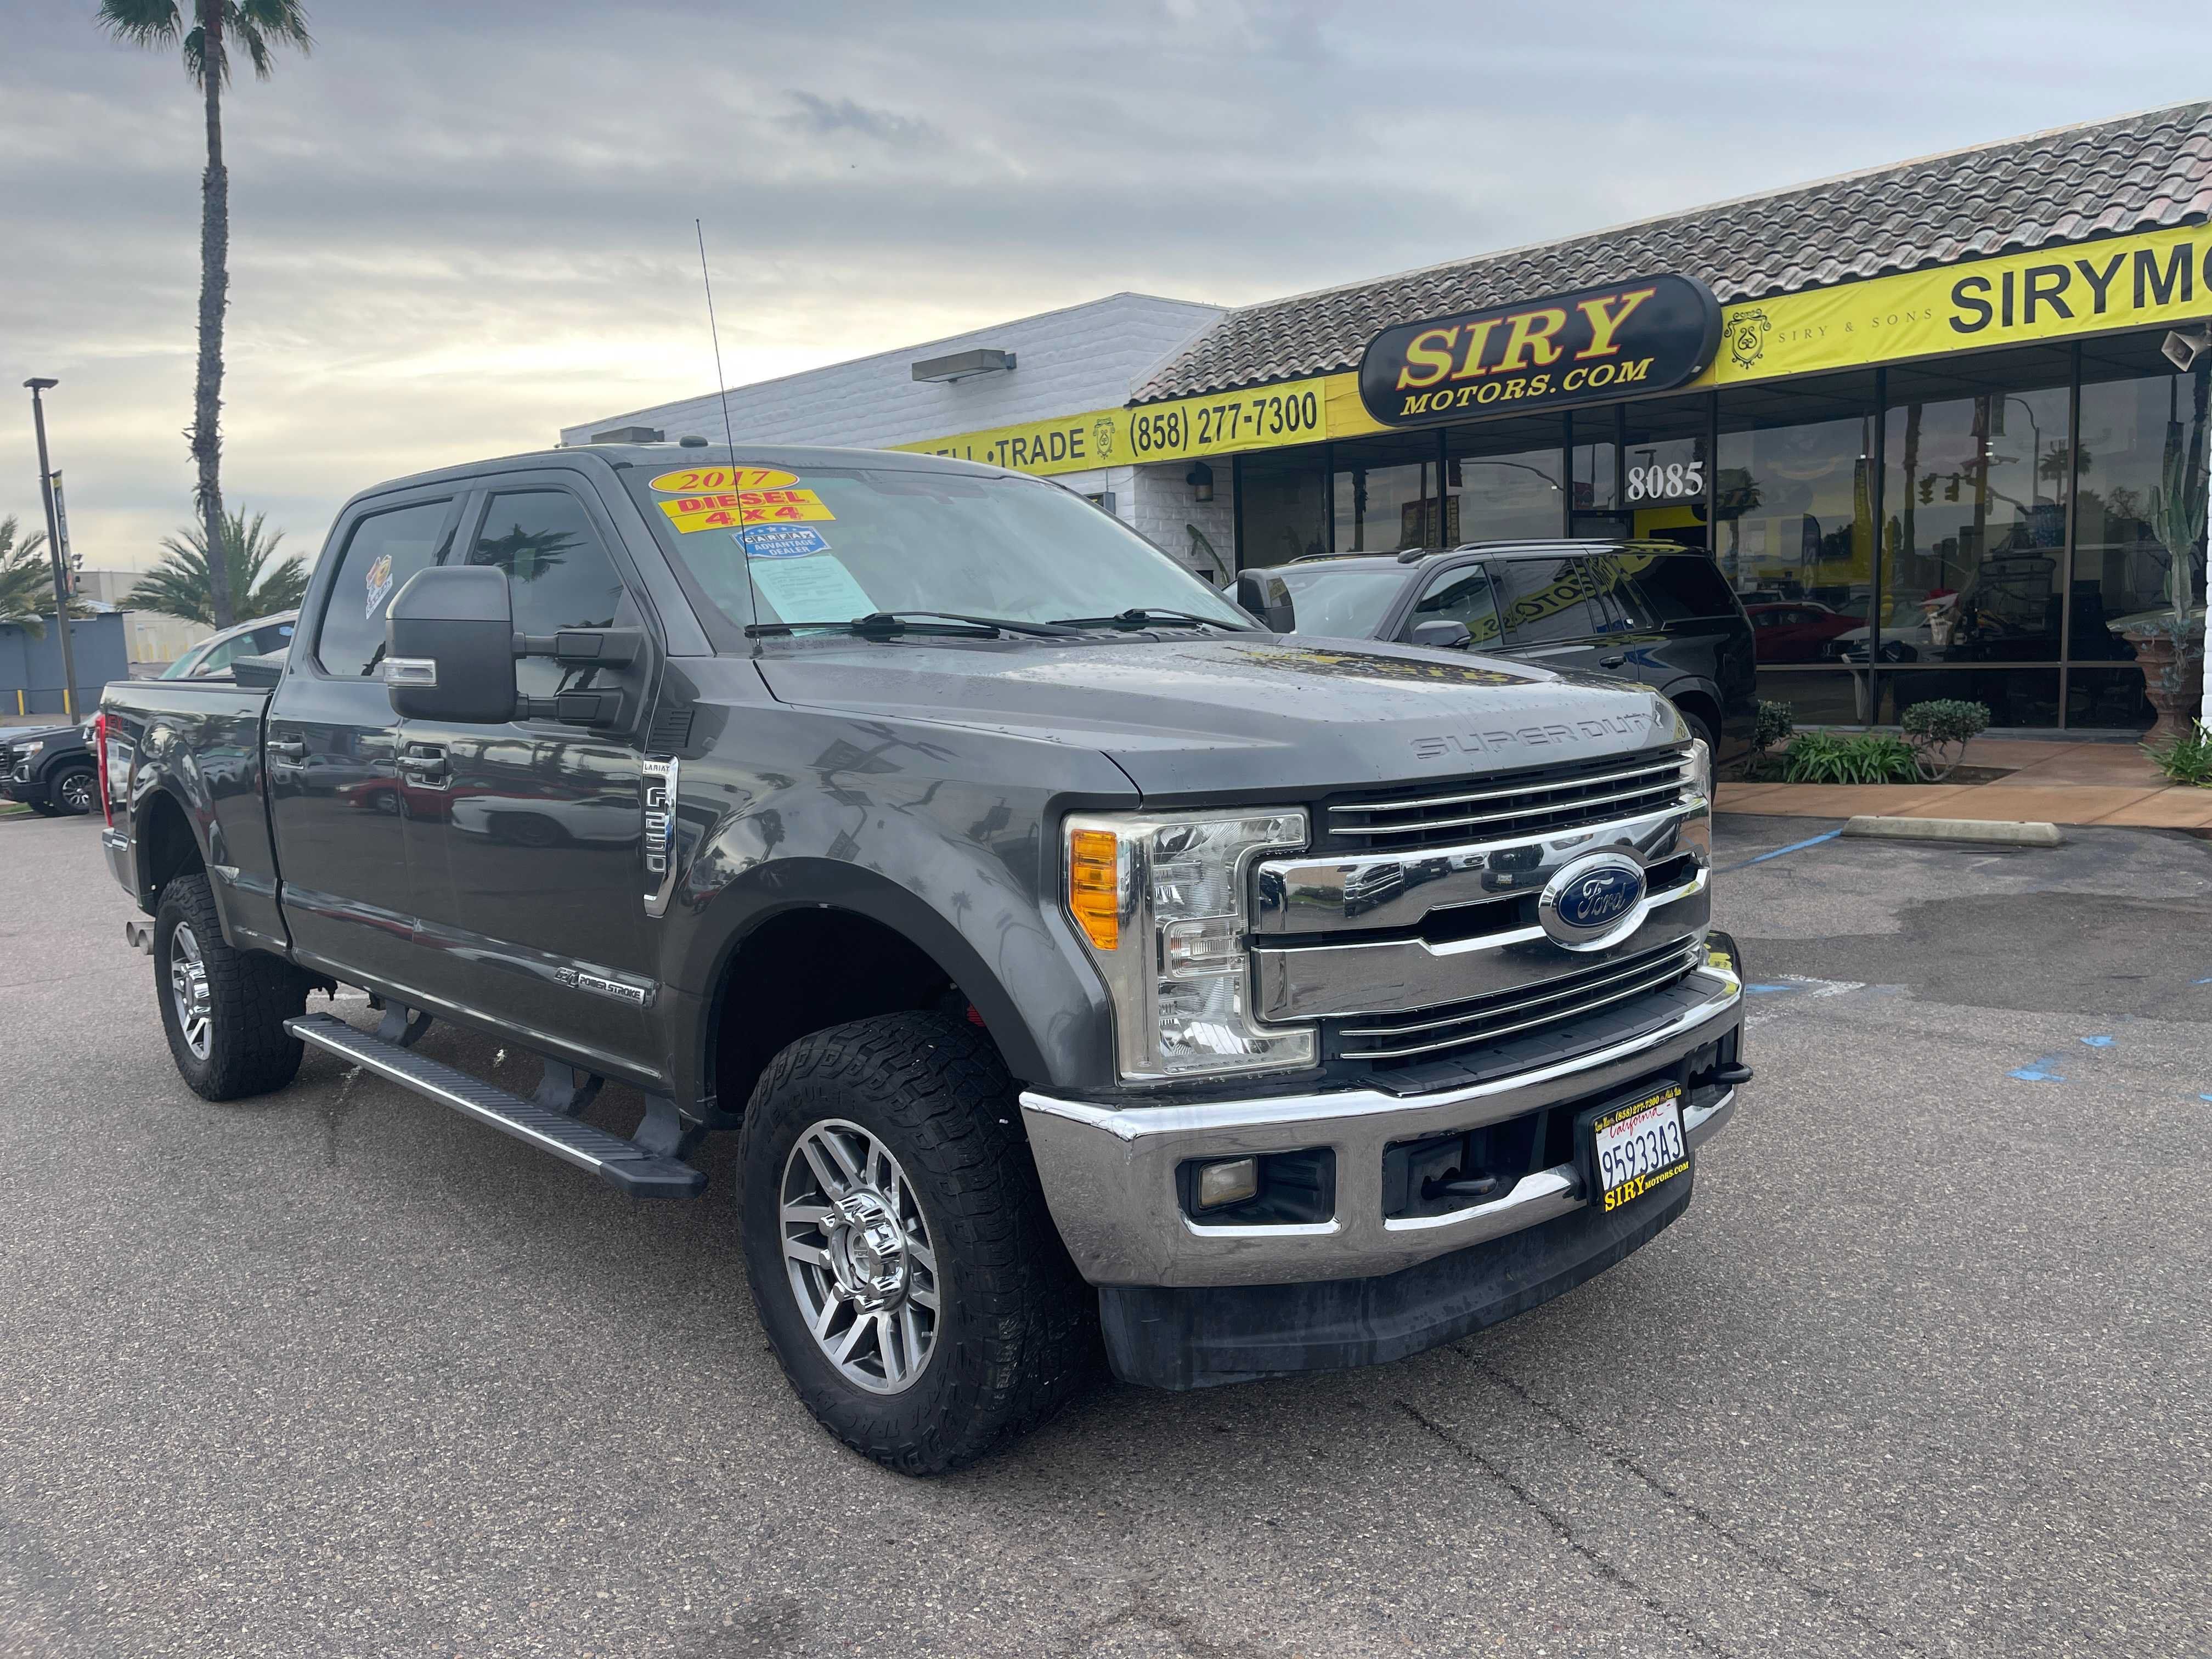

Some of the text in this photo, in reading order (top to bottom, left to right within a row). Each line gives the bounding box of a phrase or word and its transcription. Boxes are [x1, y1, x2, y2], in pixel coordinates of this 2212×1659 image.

[1949, 242, 2212, 333] SIRYM
[1396, 287, 1656, 390] SIRY
[1778, 309, 1932, 343] SIRY & SONS
[1400, 358, 1654, 416] MOTORS.COM
[1130, 392, 1317, 457] (858) 277-7300
[995, 428, 1086, 468] TRADE
[677, 471, 771, 490] 2017
[1628, 461, 1703, 501] 8085
[677, 491, 810, 512] DIESEL
[744, 531, 815, 544] CARFAX
[755, 539, 815, 550] ADVANTAGE
[769, 546, 810, 556] DEALER
[1410, 724, 1579, 760] SUPER
[1577, 711, 1664, 740] DUTY
[644, 764, 670, 773] LARIAT
[1577, 877, 1627, 919] Ford
[579, 976, 607, 991] POWER
[607, 984, 641, 1000] STROKE
[1609, 1107, 1663, 1138] California
[1615, 1096, 1660, 1122] (858) 277-7300
[1602, 1121, 1680, 1190] 95933A3
[1605, 1161, 1689, 1211] SIRY MOTORS.COM
